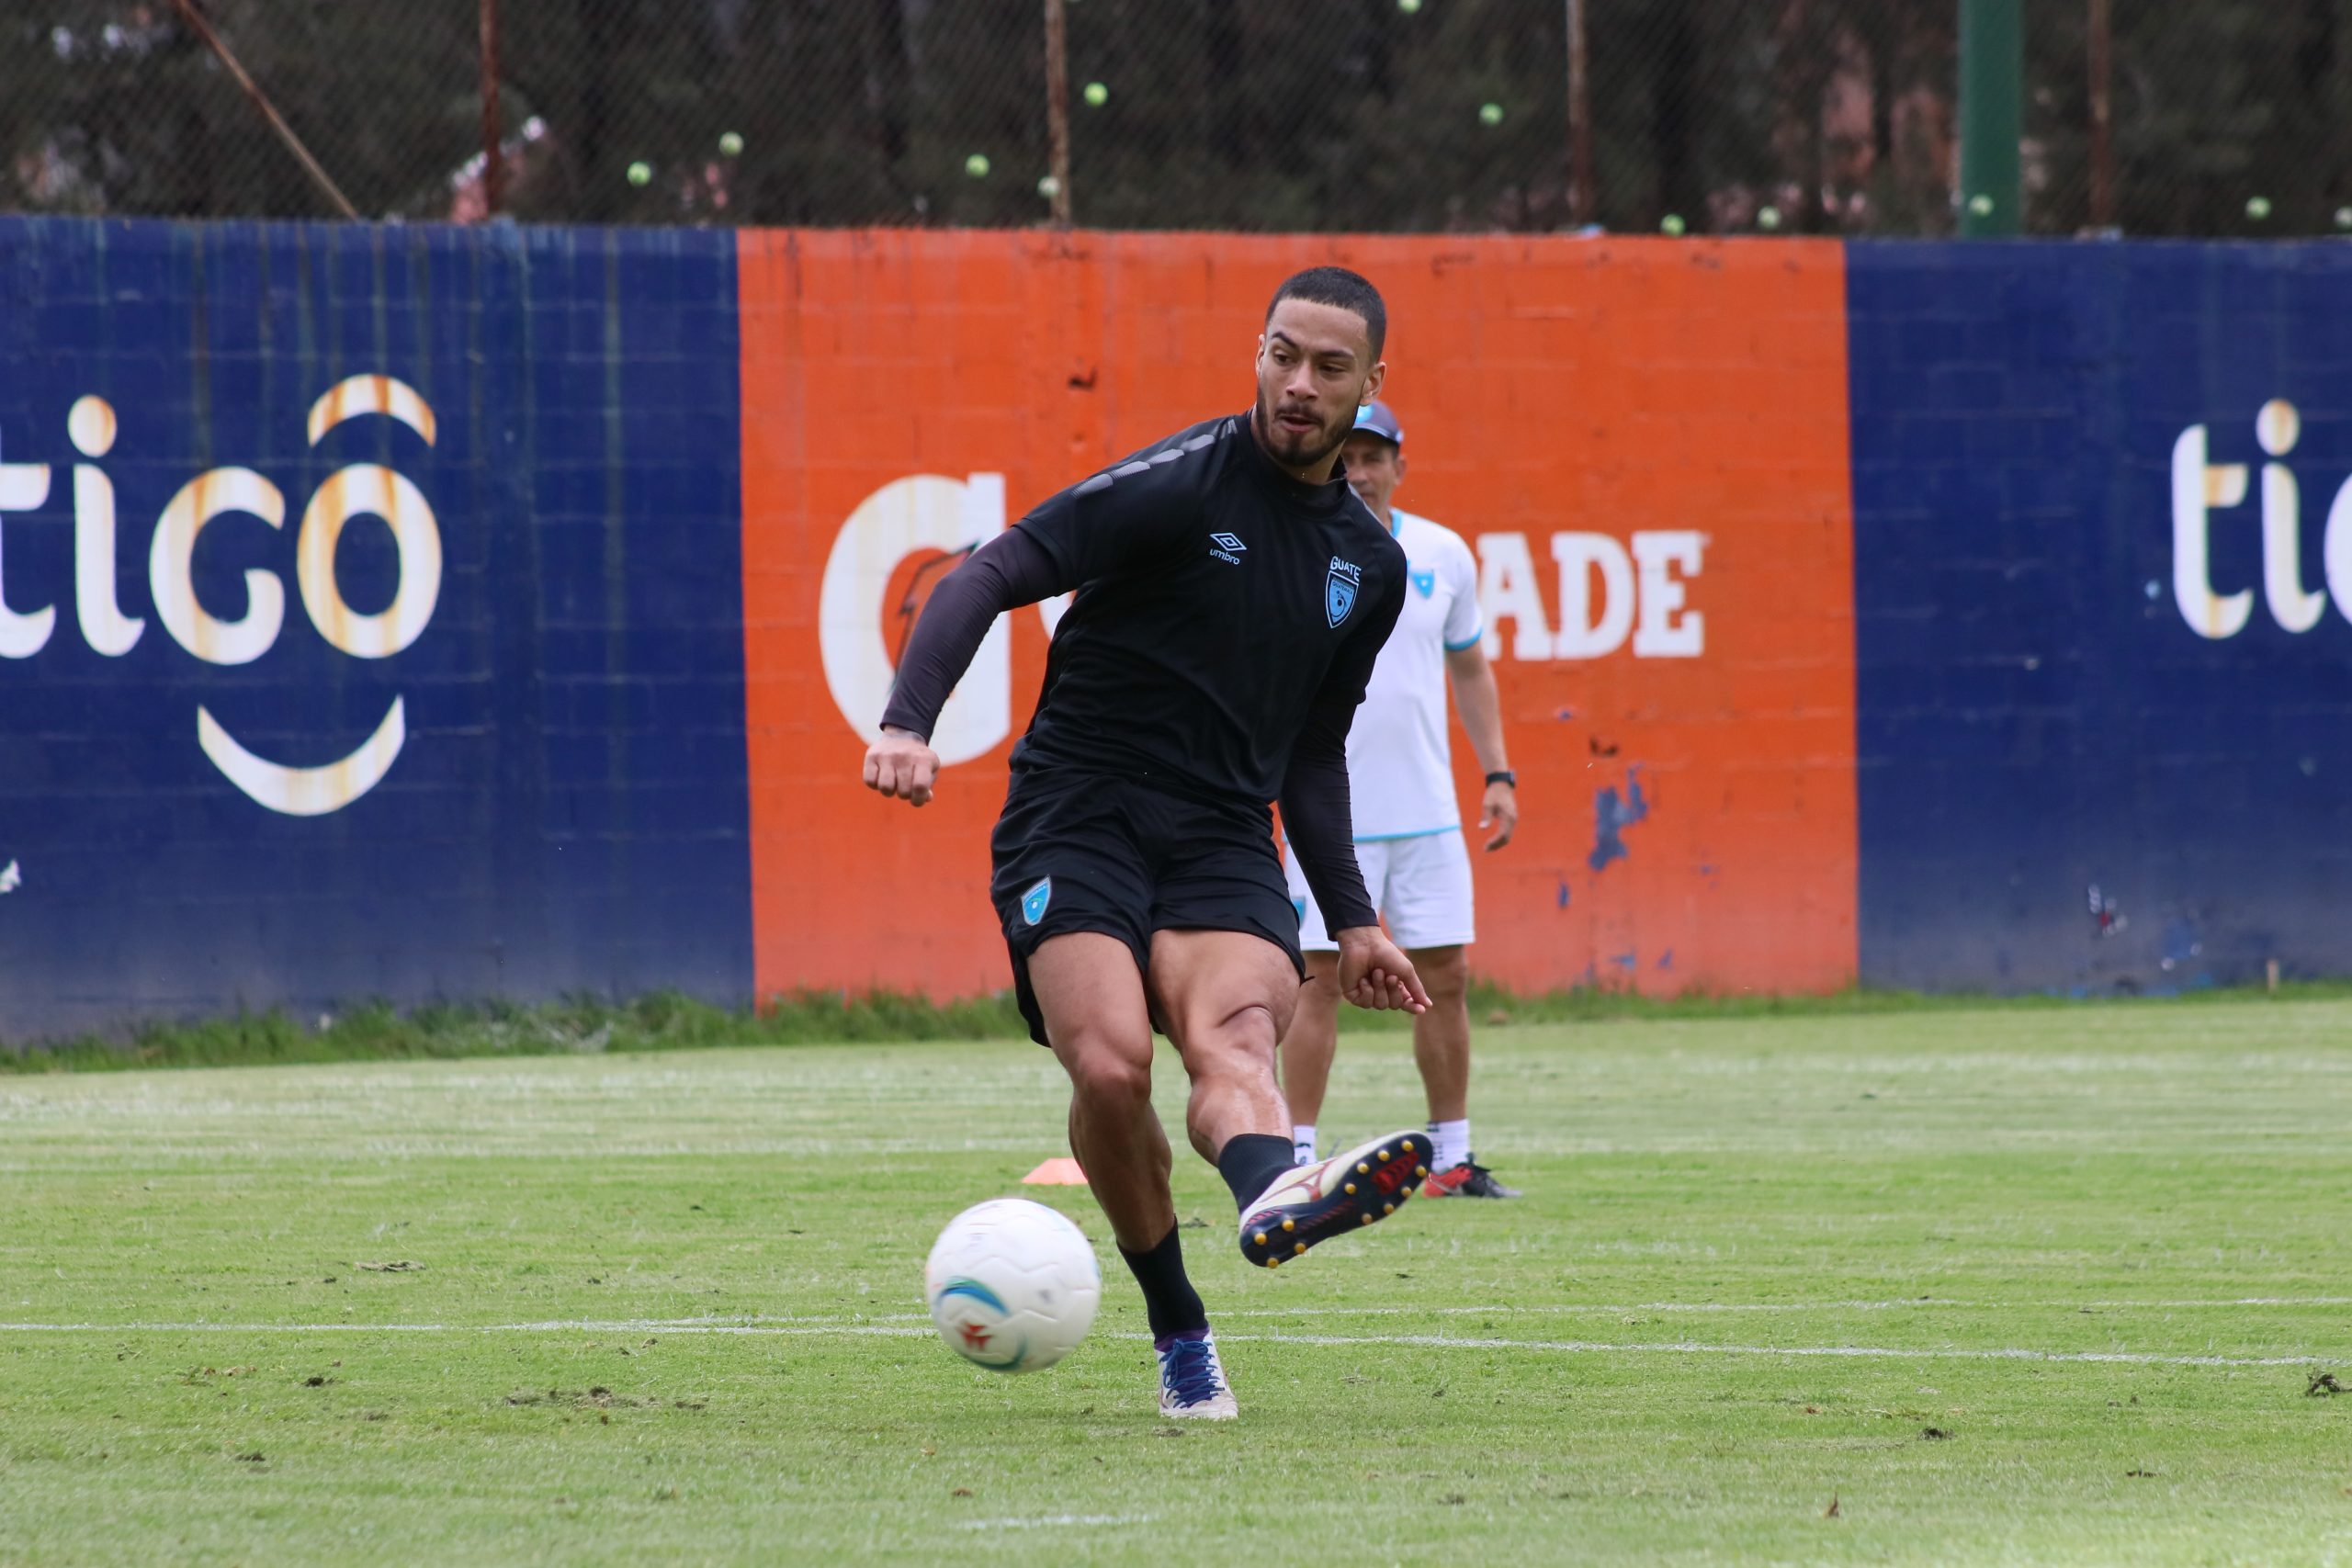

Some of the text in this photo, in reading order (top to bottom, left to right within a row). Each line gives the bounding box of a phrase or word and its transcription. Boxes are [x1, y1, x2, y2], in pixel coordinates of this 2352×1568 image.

[2171, 399, 2352, 639] ti
[1209, 548, 1240, 565] umbro
[1329, 556, 1362, 582] GUATE
